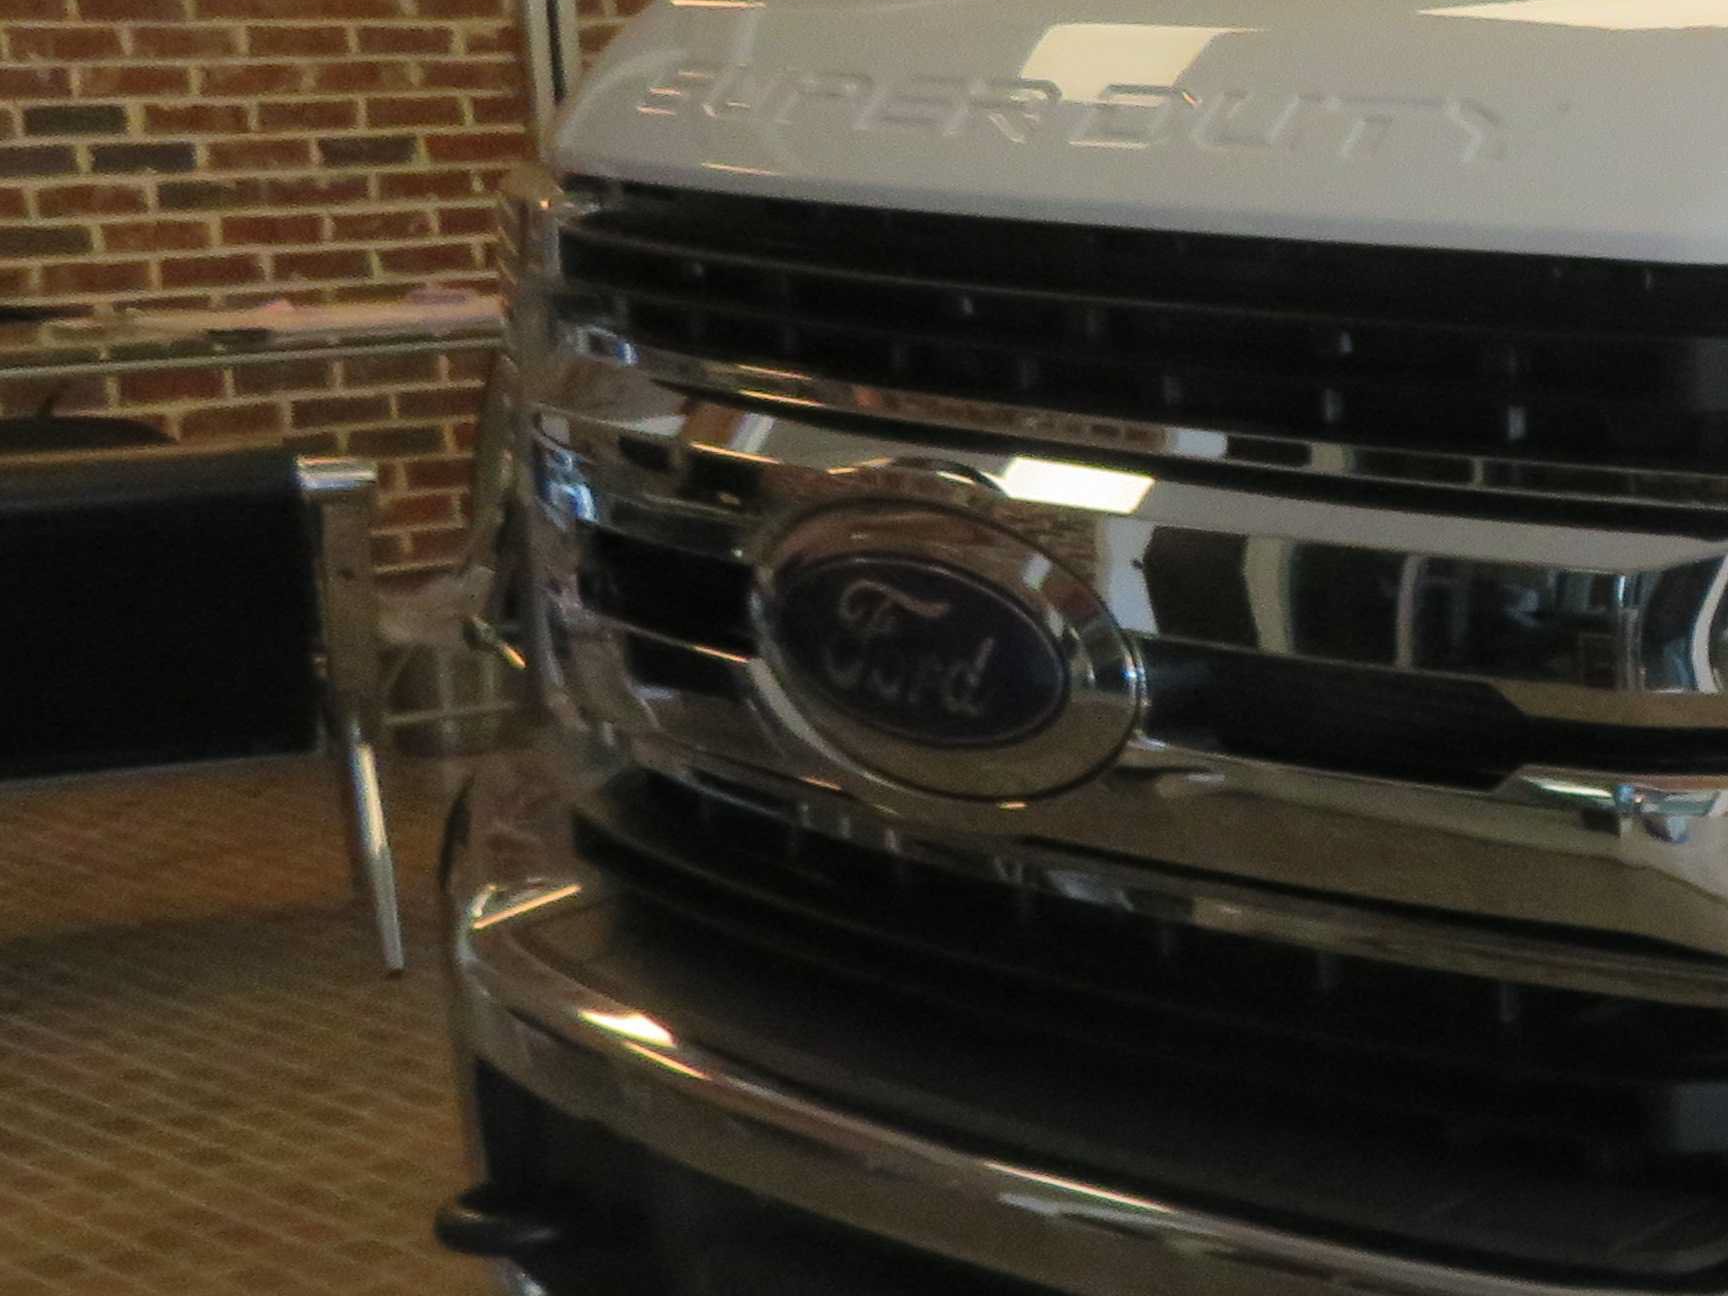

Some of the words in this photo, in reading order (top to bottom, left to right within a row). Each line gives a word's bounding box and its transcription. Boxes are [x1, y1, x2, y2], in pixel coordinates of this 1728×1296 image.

[636, 56, 1064, 144] SUPER
[1067, 81, 1513, 164] DUTY
[822, 577, 996, 718] Ford
